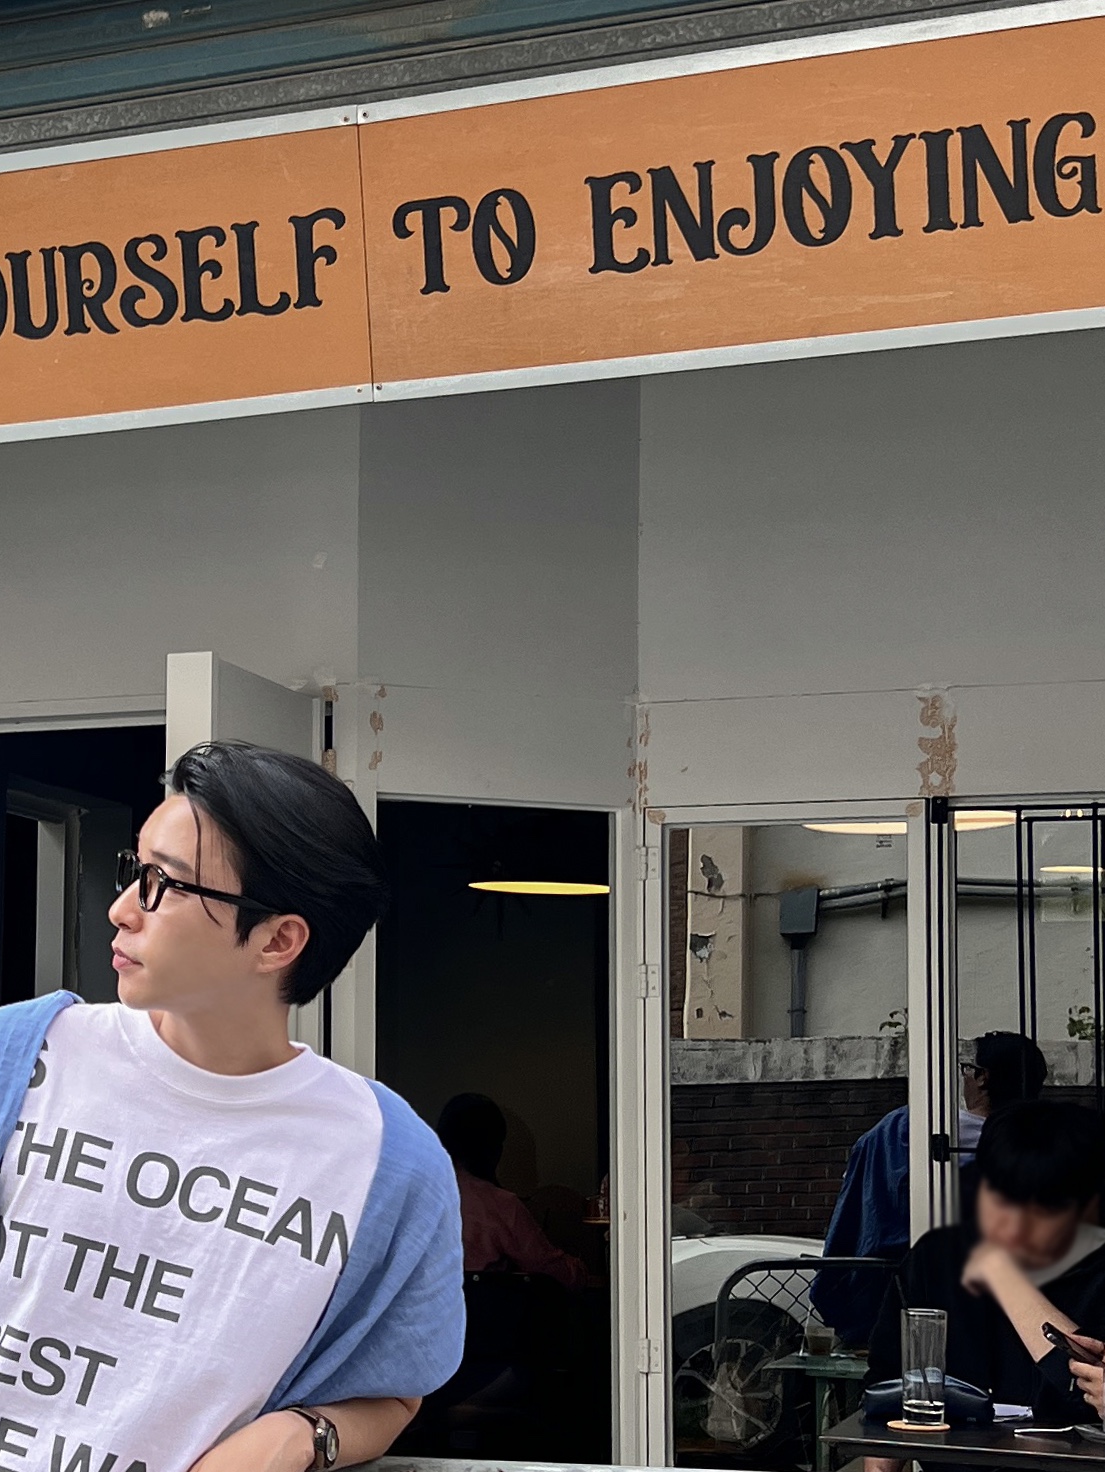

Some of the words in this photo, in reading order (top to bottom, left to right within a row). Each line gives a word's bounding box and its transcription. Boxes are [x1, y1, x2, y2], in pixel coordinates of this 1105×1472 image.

[393, 187, 536, 295] TO
[583, 111, 1103, 275] ENJOYING
[62, 1232, 194, 1323] THE
